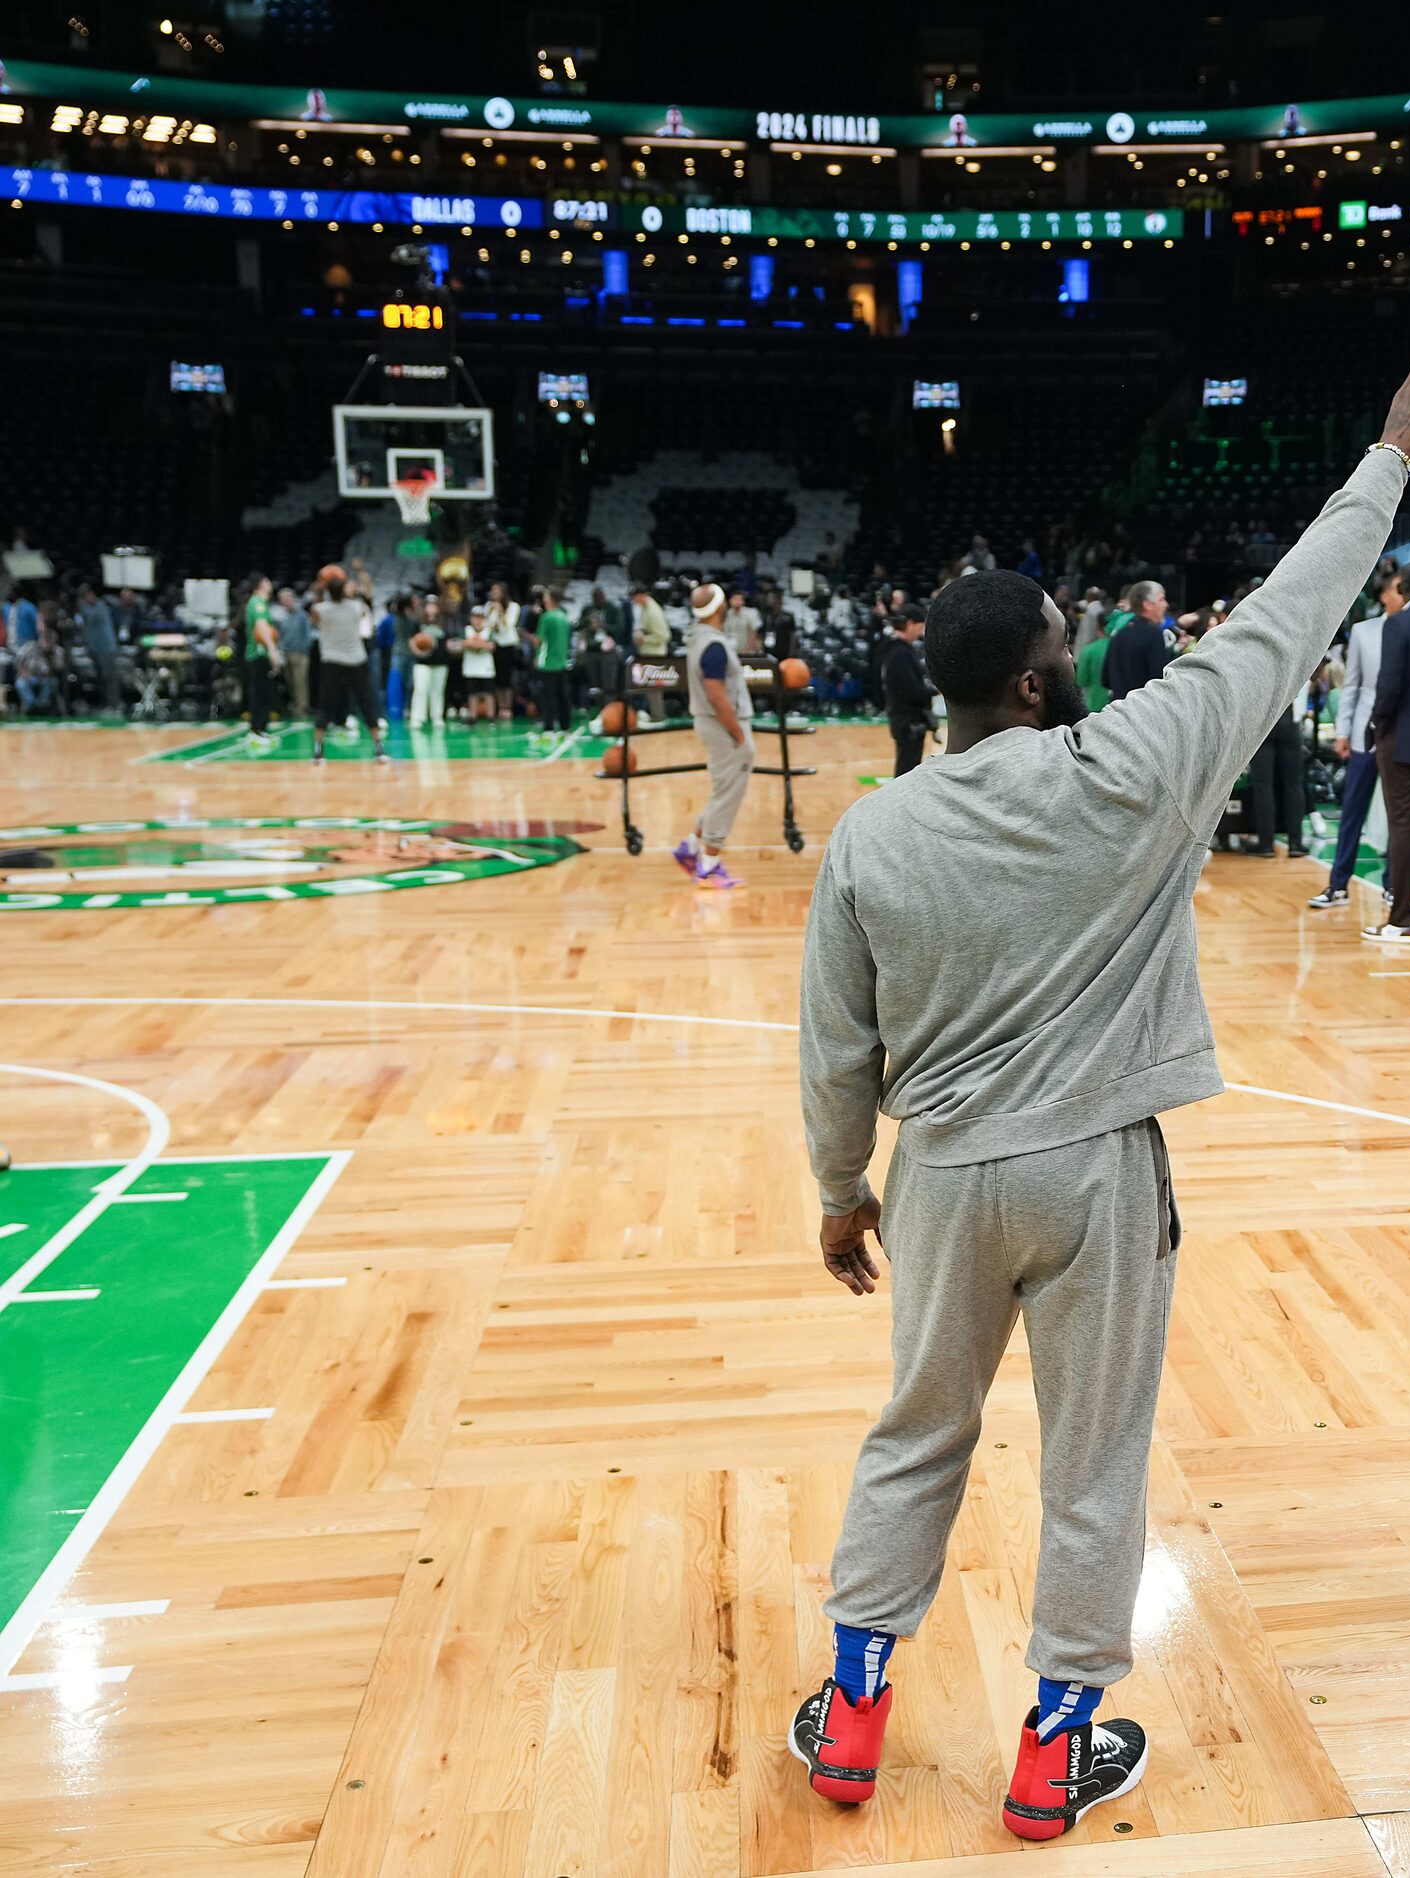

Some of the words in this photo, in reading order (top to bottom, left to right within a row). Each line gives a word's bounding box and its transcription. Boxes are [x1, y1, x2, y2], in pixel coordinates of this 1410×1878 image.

[757, 112, 808, 141] 2024
[812, 114, 880, 144] FINALS
[412, 197, 475, 224] DALLAS
[500, 200, 522, 227] 0
[553, 199, 608, 221] 07:21
[642, 206, 663, 232] 0
[686, 207, 751, 233] BOSTON
[1368, 205, 1402, 222] Bank
[0, 870, 466, 909] CELTIC
[813, 1687, 832, 1754] SMMGOD
[1069, 1734, 1082, 1799] SHMMGOD
